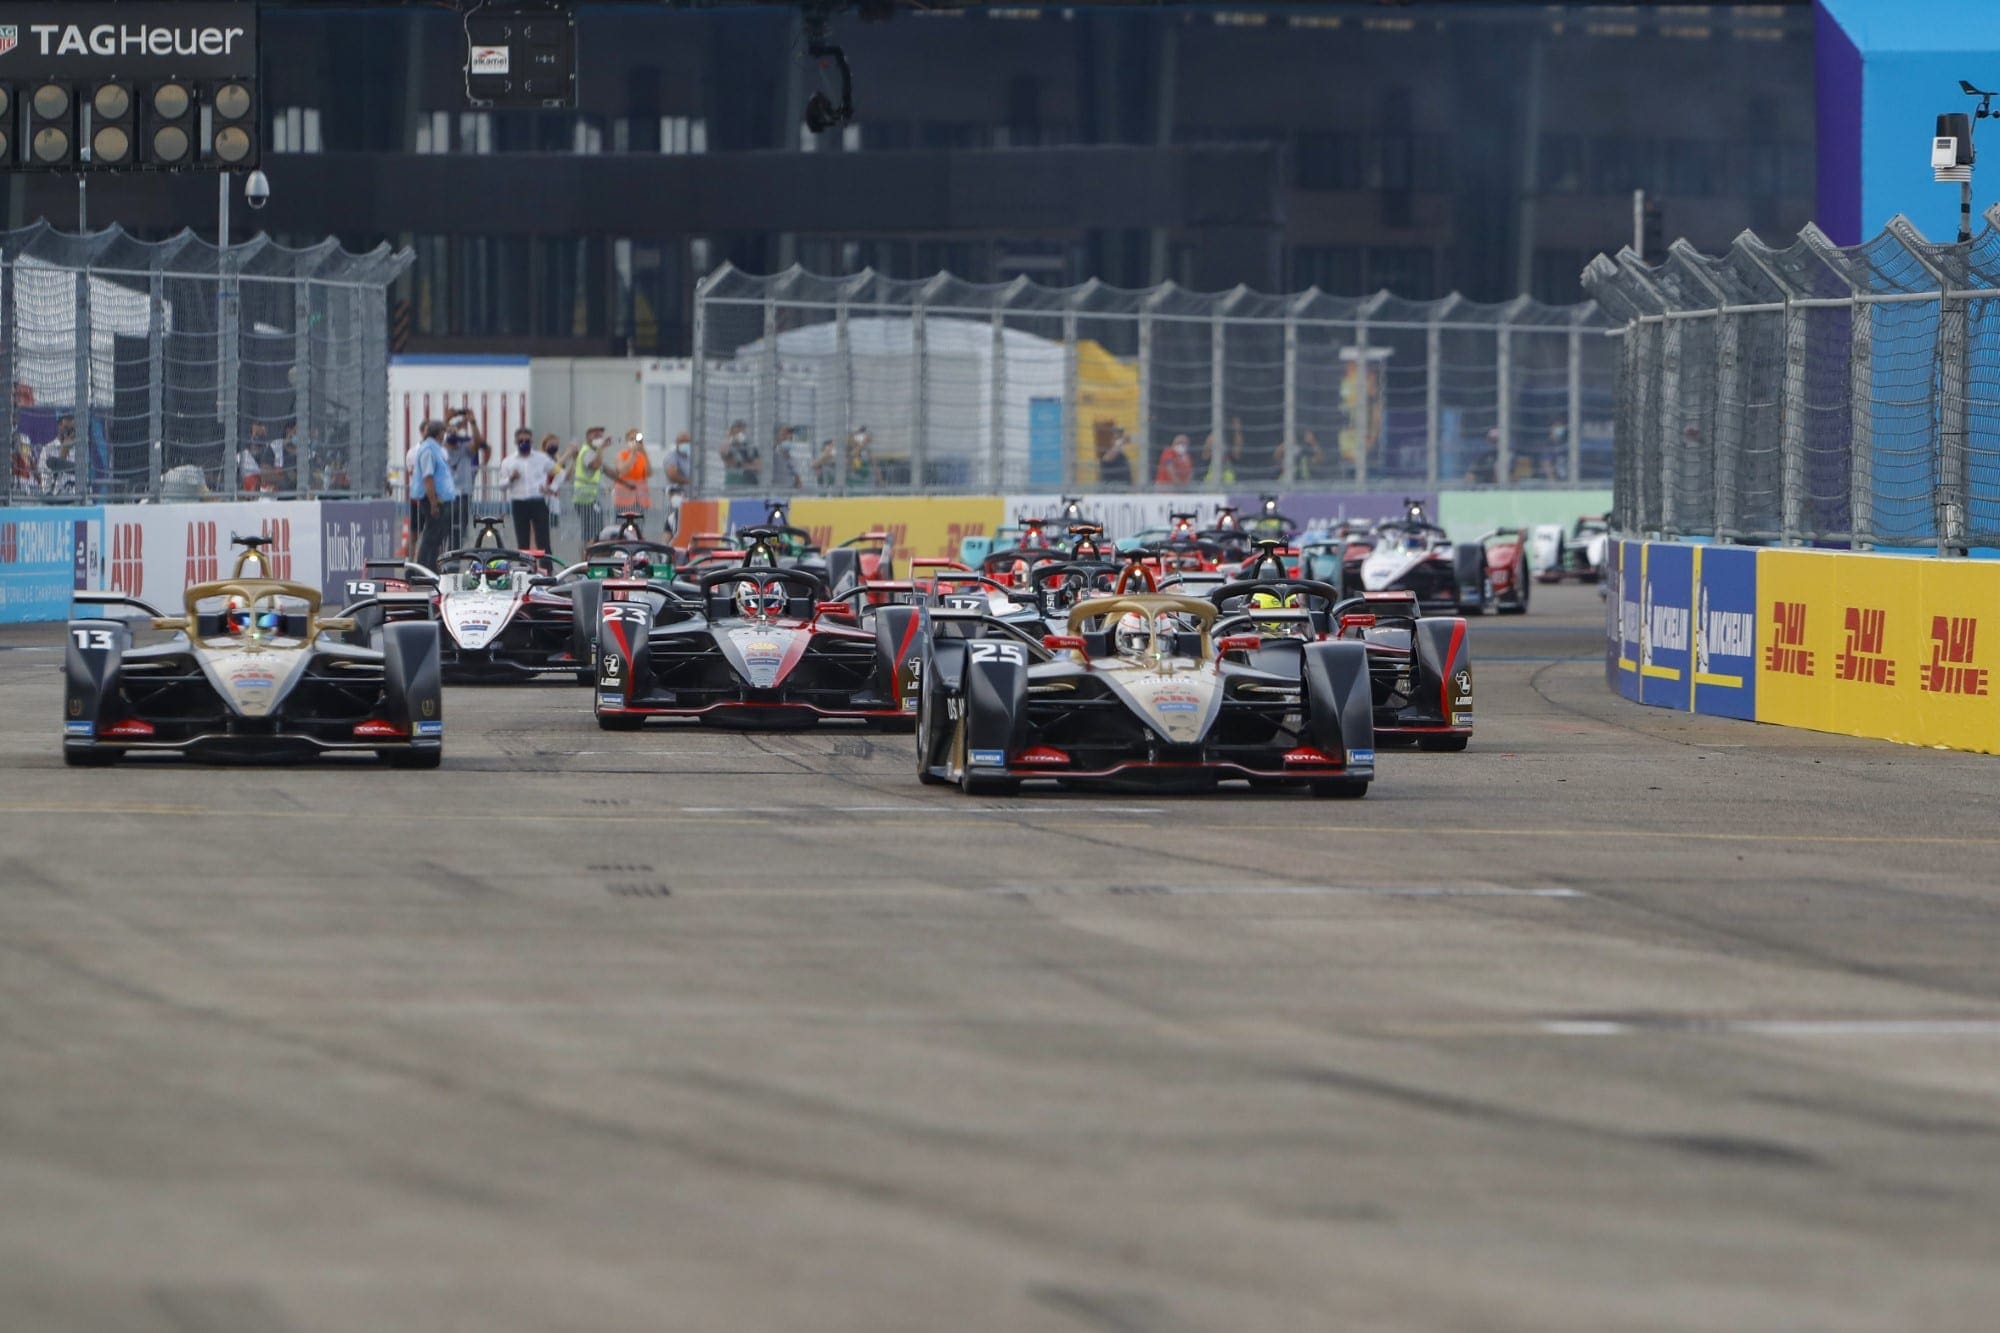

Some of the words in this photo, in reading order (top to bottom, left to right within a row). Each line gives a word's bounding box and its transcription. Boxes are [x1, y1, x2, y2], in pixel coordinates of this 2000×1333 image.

[110, 522, 144, 598] ABB
[185, 520, 218, 590] ABB
[326, 521, 350, 584] Julius
[346, 582, 375, 595] 19
[602, 606, 647, 626] 23
[1652, 605, 1689, 651] MICHELIN
[72, 629, 114, 650] 13
[1709, 610, 1754, 658] MICHELIN
[971, 643, 1023, 667] 25
[1283, 753, 1327, 761] TOTAL
